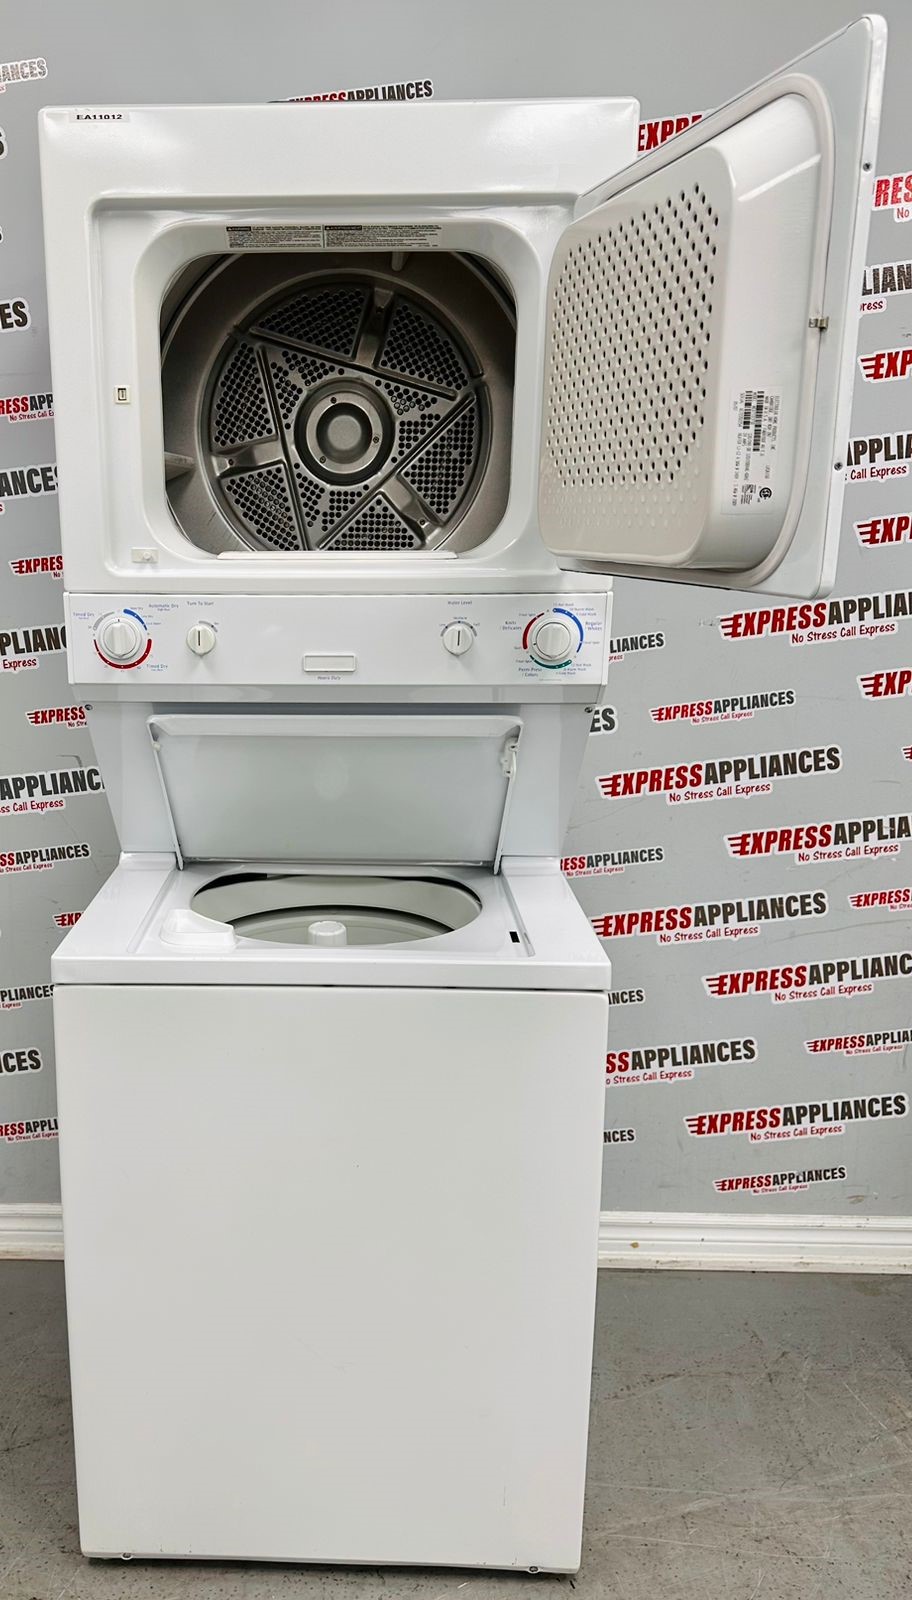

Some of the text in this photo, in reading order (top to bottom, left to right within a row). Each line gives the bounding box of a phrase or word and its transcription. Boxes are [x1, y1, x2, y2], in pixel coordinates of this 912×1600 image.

[897, 207, 910, 219] No
[37, 410, 47, 418] Call
[850, 465, 907, 480] Call Express
[791, 623, 895, 643] No Stress Call Express
[3, 658, 37, 671] Express
[651, 690, 794, 721] EXPRESSAPPLIANCES
[27, 706, 86, 724] EXPRESS
[598, 747, 841, 797] EXPRESSAPPLIANCES
[669, 783, 771, 802] No Stress Call Express
[13, 802, 28, 812] Call
[31, 800, 64, 812] Express
[798, 844, 899, 862] No Stress Call Express
[591, 892, 826, 937] EXPRESSAPPLIANCES
[660, 926, 758, 943] No Stress Call Express
[774, 983, 872, 1001] No Stress Call Express
[613, 1074, 640, 1084] Stress
[643, 1072, 657, 1082] Call
[659, 1068, 692, 1082] Express
[686, 1095, 906, 1136] EXPRESSAPPLIANCES
[750, 1124, 842, 1141] No Stress Call Express
[715, 1167, 846, 1192] EXPRESSAPPLIANCES
